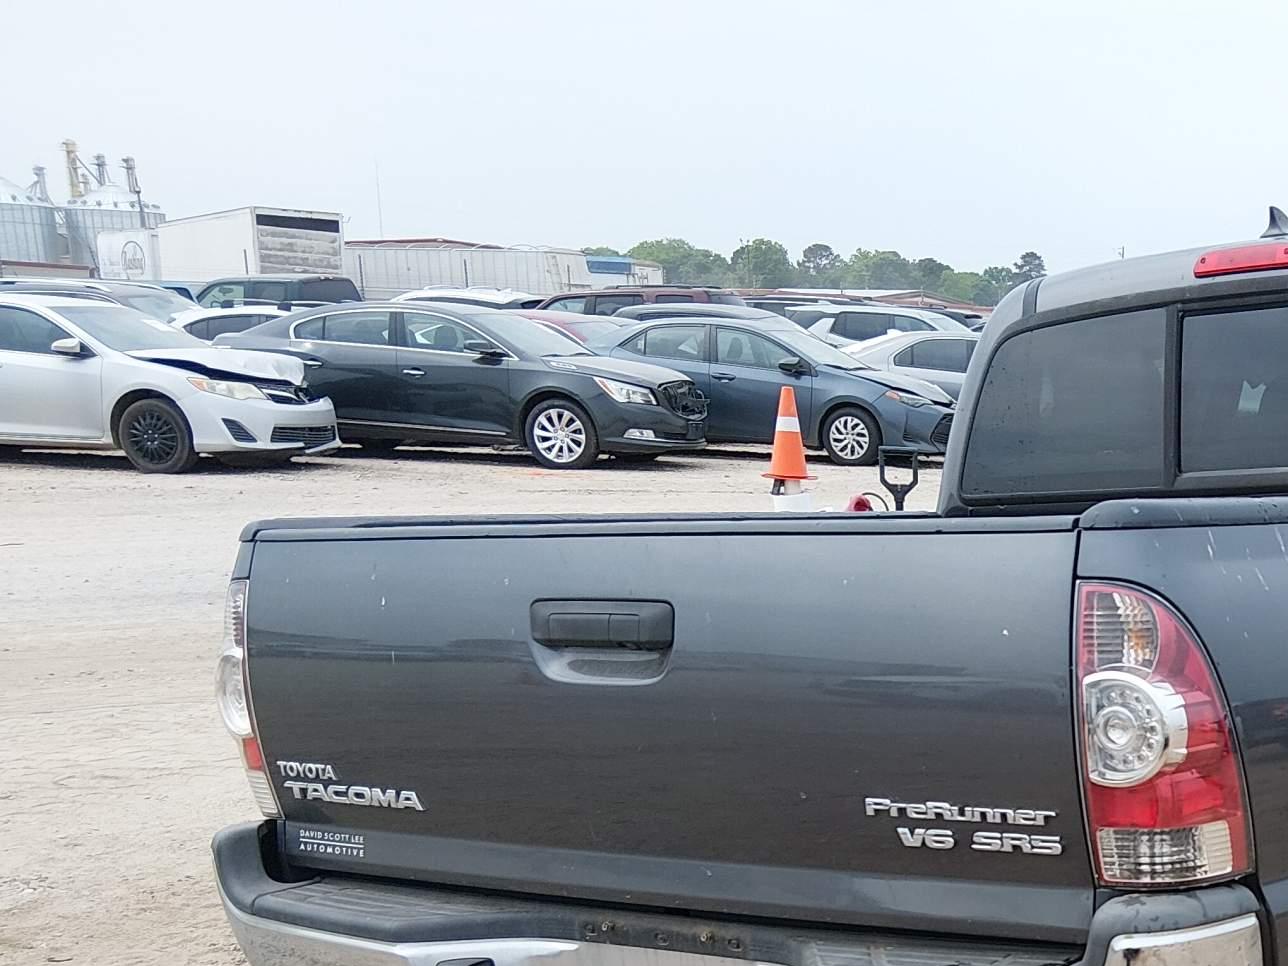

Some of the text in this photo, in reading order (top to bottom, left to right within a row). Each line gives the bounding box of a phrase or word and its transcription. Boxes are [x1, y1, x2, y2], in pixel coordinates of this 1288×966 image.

[277, 761, 337, 780] TOYOTA
[283, 781, 424, 810] TACOMA
[865, 797, 1056, 825] PreRunner
[300, 829, 364, 844] DAVID SCOTT LEE
[896, 827, 1062, 855] V6 SR5
[299, 843, 364, 857] AUTOMOTIVE
